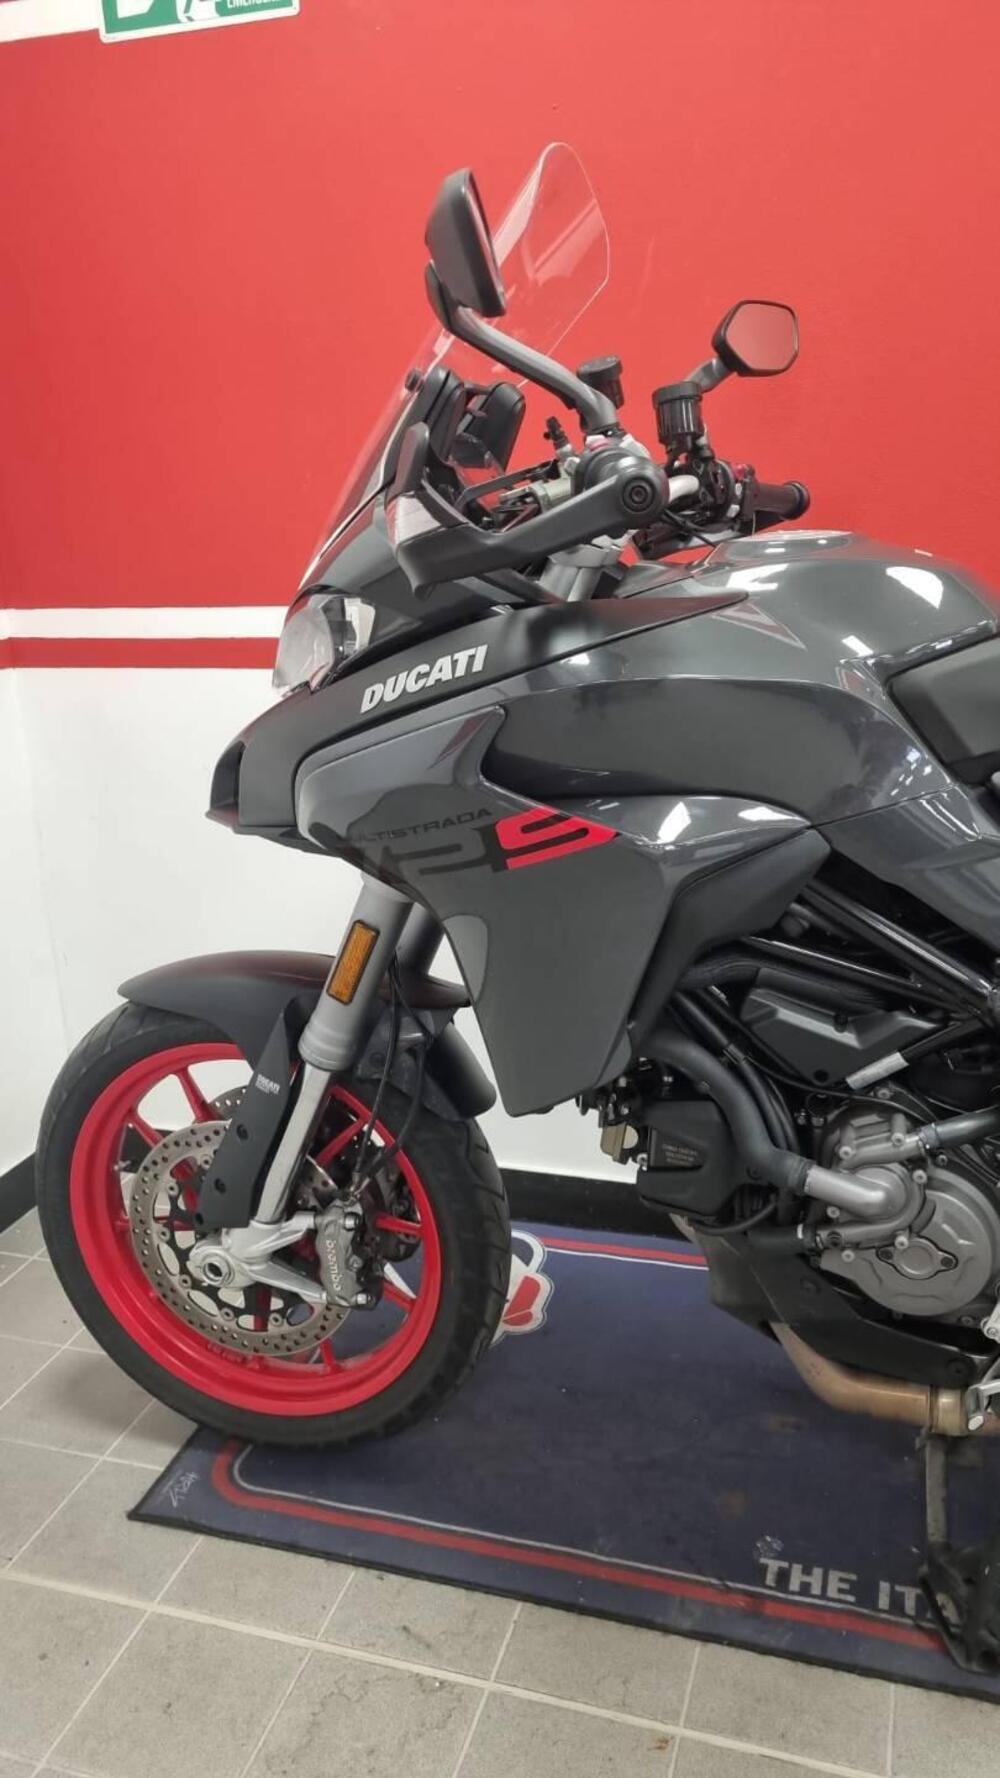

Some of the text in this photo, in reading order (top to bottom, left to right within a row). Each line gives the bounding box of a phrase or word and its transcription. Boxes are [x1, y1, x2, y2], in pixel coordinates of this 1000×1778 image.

[360, 644, 488, 713] DUCATI
[325, 1239, 341, 1292] brembo
[759, 1557, 858, 1602] THE
